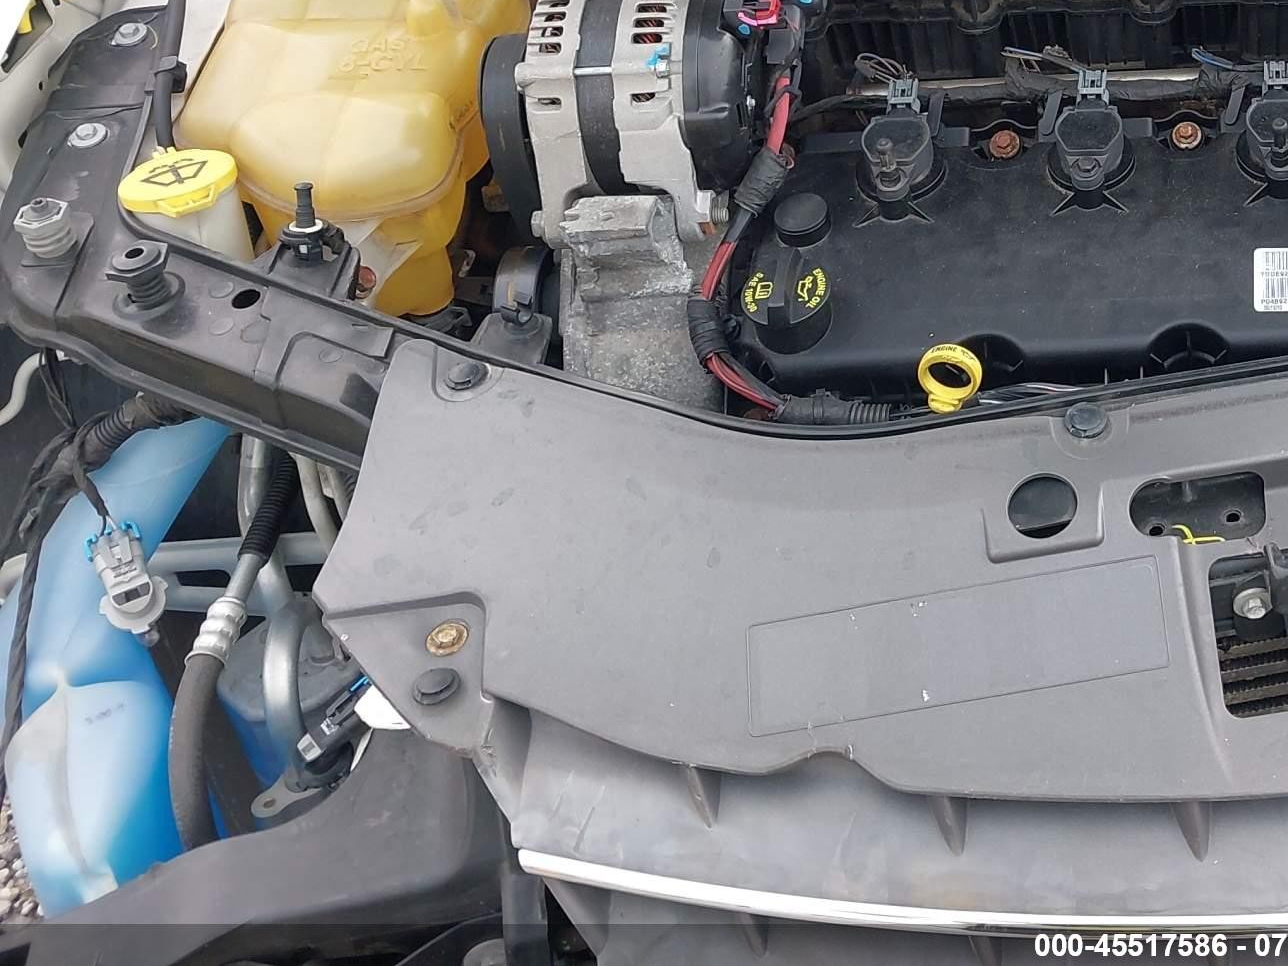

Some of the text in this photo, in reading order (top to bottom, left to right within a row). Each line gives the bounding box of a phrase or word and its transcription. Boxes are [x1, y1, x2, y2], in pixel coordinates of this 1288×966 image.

[748, 272, 765, 287] SAE
[805, 268, 827, 309] ENGINE OIL
[931, 345, 957, 354] ENGINE
